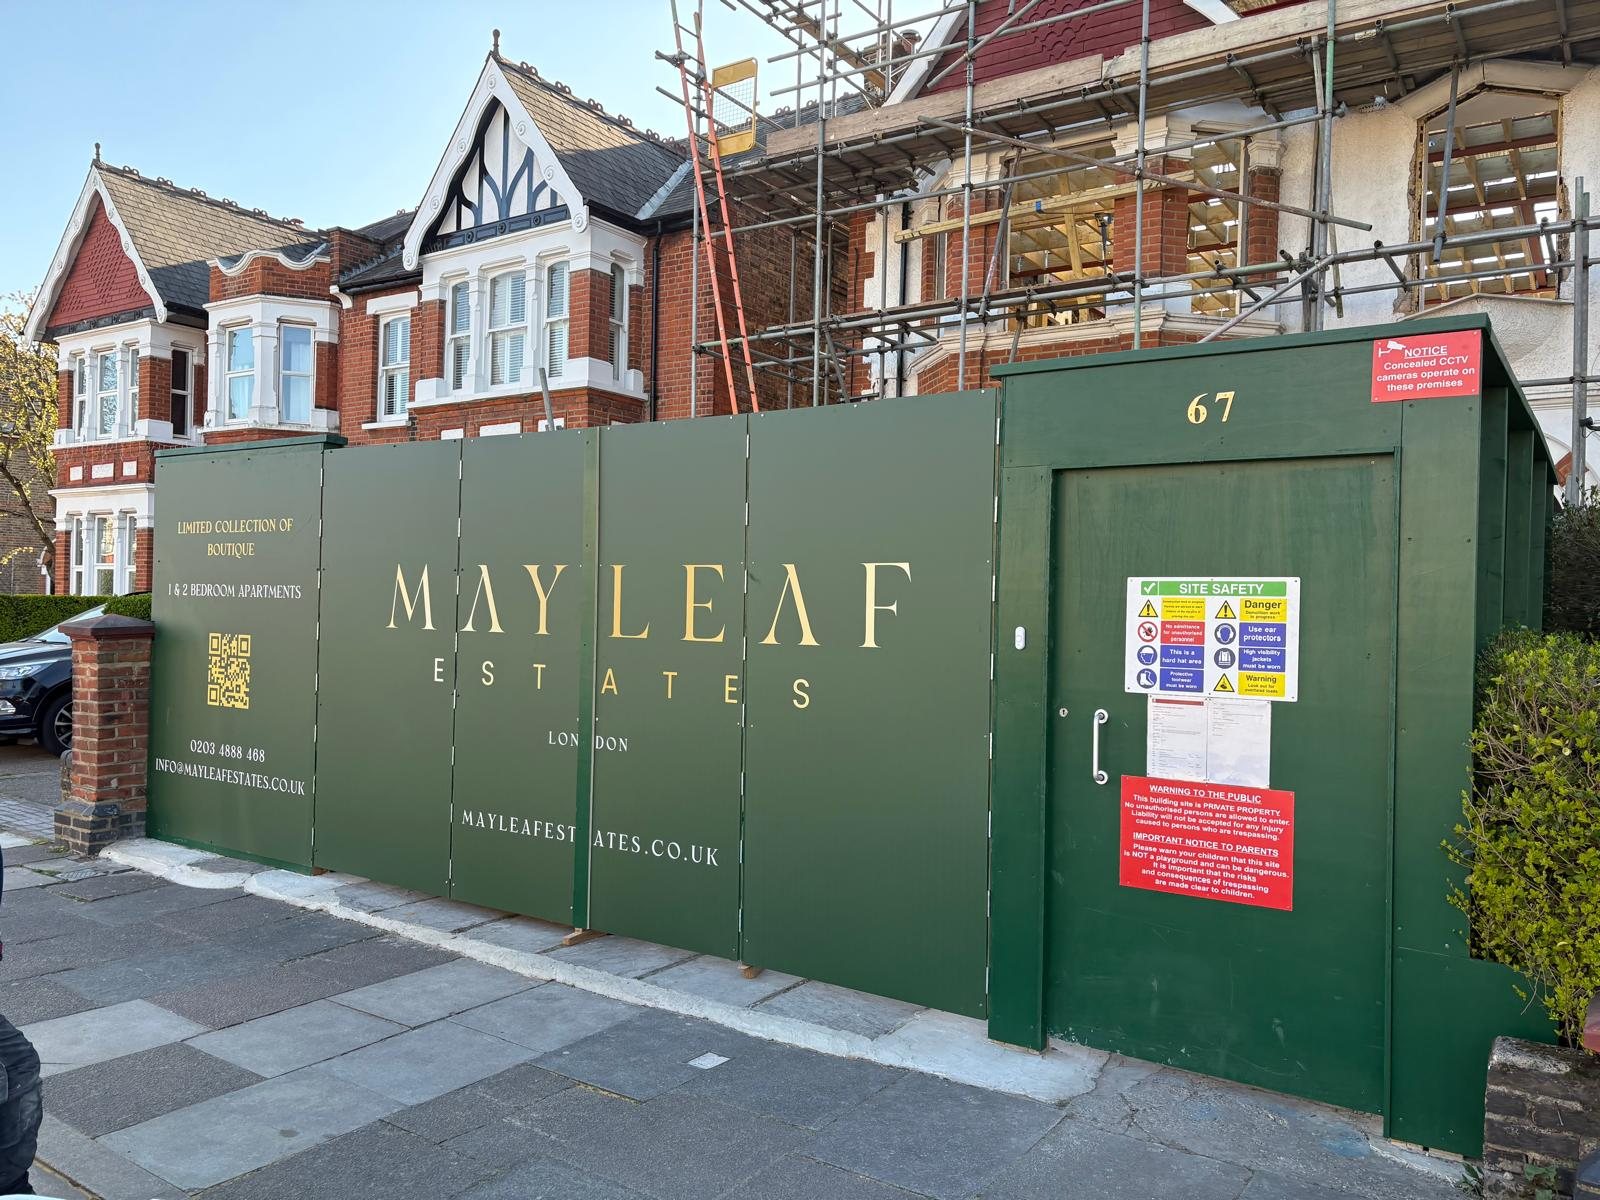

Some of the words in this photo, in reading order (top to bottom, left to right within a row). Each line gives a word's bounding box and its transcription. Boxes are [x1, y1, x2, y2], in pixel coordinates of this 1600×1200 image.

[1404, 346, 1447, 357] NOTICE
[1384, 359, 1436, 370] Concealed
[1440, 355, 1468, 365] CCTV
[1377, 372, 1418, 381] cameras
[1421, 369, 1459, 379] operate
[1387, 383, 1413, 391] these
[1417, 380, 1463, 390] premises
[1188, 391, 1235, 424] 67
[178, 521, 212, 534] LIMITED
[215, 519, 276, 533] COLLECTION
[279, 518, 293, 532] OF
[208, 543, 254, 558] BOUTIQUE
[174, 584, 180, 596] &
[183, 584, 188, 596] 2
[191, 584, 235, 597] BEDROOM
[238, 585, 301, 599] APARTMENTS
[1180, 584, 1208, 594] SITE
[1212, 584, 1264, 594] SAFETY
[385, 563, 912, 648] MAYLEAF
[1245, 600, 1282, 610] Danger
[434, 658, 810, 708] ESTATES
[1246, 675, 1276, 683] Warning
[548, 731, 628, 751] LONDON
[190, 739, 215, 754] 0203
[219, 744, 242, 759] 4888
[247, 748, 265, 762] 468
[156, 758, 304, 795] INFO@MAYLEAFESTATES.CO.UK
[1150, 784, 1190, 795] WARNING
[1194, 789, 1205, 797] TO
[1208, 790, 1225, 799] THE
[1228, 793, 1261, 803] PUBLIC
[1133, 794, 1148, 802] This
[1150, 797, 1178, 806] building
[1204, 803, 1235, 812] PRIVATE
[1132, 810, 1158, 819] Liability
[1199, 819, 1231, 827] accepted
[1262, 825, 1283, 833] injury
[1136, 803, 1182, 813] unauthorised
[1184, 809, 1213, 817] persons
[1229, 813, 1257, 822] allowed
[462, 809, 718, 866] MAYLEAFESTATES.CO.UK
[1171, 823, 1200, 831] persons
[1233, 830, 1279, 841] trespassing.
[1133, 832, 1183, 844] IMPORTANT
[1186, 839, 1218, 849] NOTICE
[1236, 845, 1279, 856] PARENTS
[1133, 844, 1157, 852] Please
[1198, 852, 1228, 861] children
[1156, 855, 1198, 865] playground
[1244, 866, 1289, 878] dangerous.
[1168, 864, 1204, 874] important
[1238, 873, 1256, 882] risks
[1157, 871, 1211, 884] consequences
[1223, 881, 1269, 894] trespassing
[1168, 881, 1189, 889] made
[1191, 883, 1209, 891] clear
[1221, 888, 1255, 898] children.
